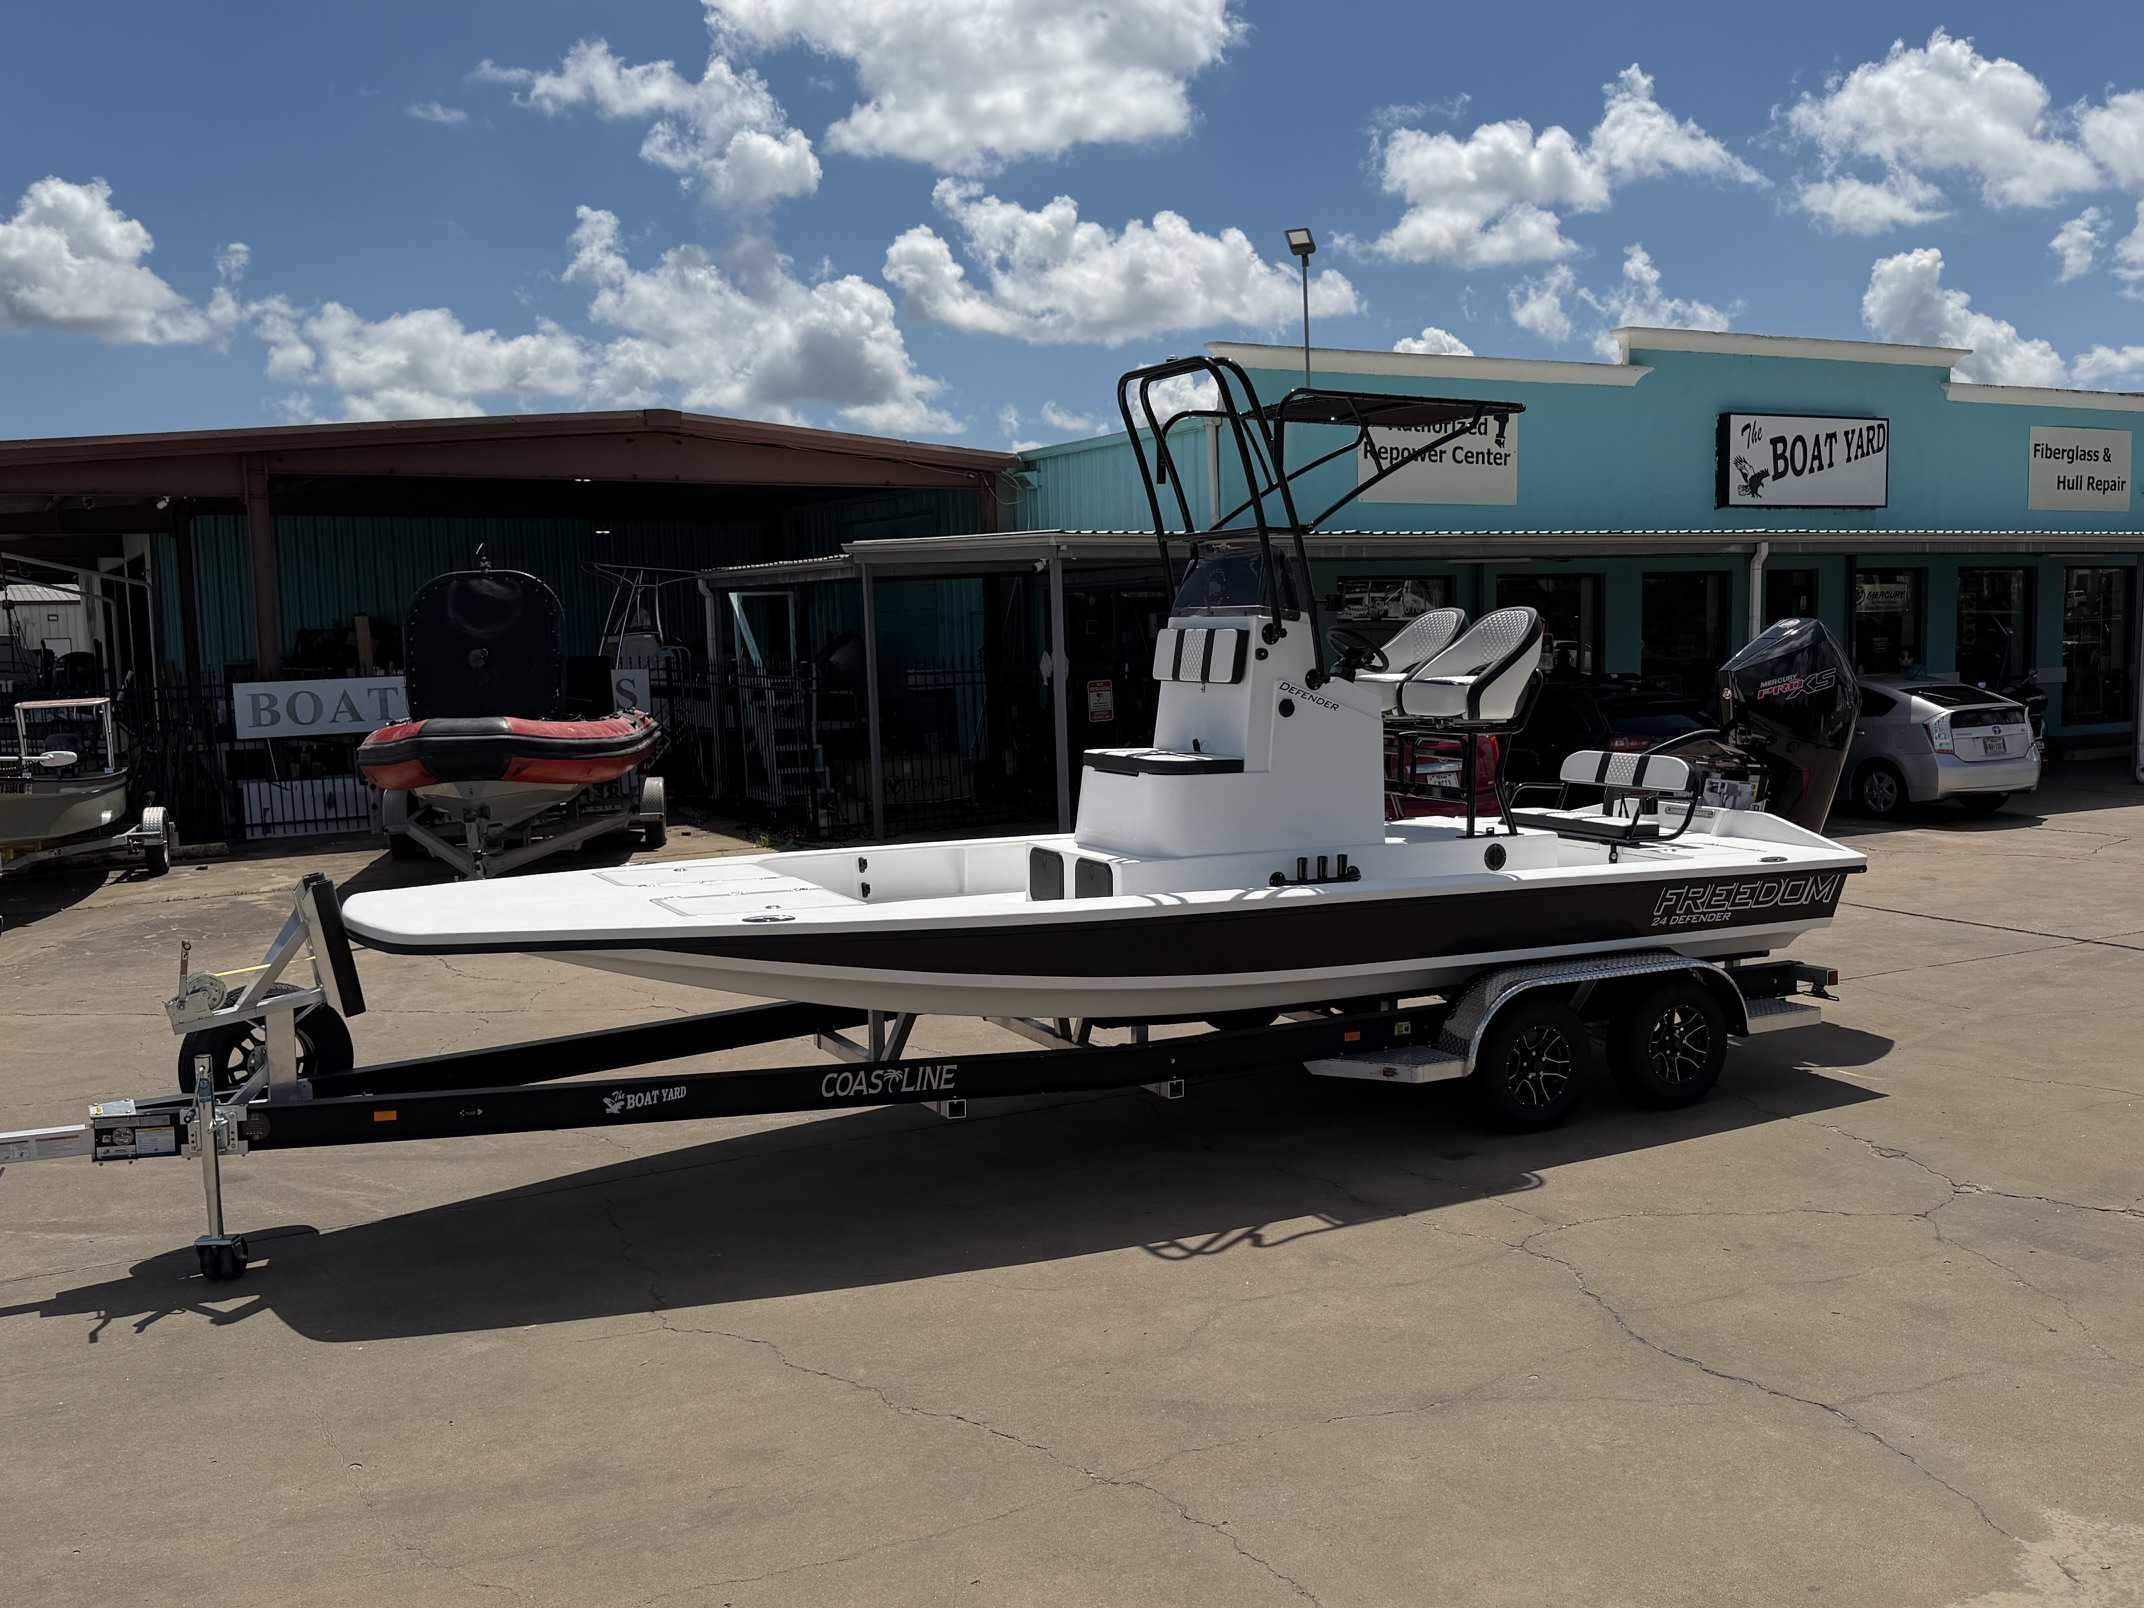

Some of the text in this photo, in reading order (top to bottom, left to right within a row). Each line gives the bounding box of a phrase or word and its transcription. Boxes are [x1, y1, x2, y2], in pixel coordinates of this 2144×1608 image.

[1388, 417, 1488, 435] uorized
[1741, 419, 1763, 449] The
[1452, 446, 1511, 467] Center
[1769, 423, 1886, 482] BOAT YARD
[2033, 443, 2112, 465] Fiberglass &
[2056, 475, 2127, 495] Hull Repair
[1760, 673, 1798, 688] MERCURY
[247, 686, 399, 728] BOAT
[1279, 681, 1340, 711] DEFENDER
[1653, 874, 1841, 916] FREEDOM
[1650, 912, 1732, 927] 24 DEFENDER
[611, 1090, 626, 1102] The
[626, 1086, 687, 1110] BOAT YARD
